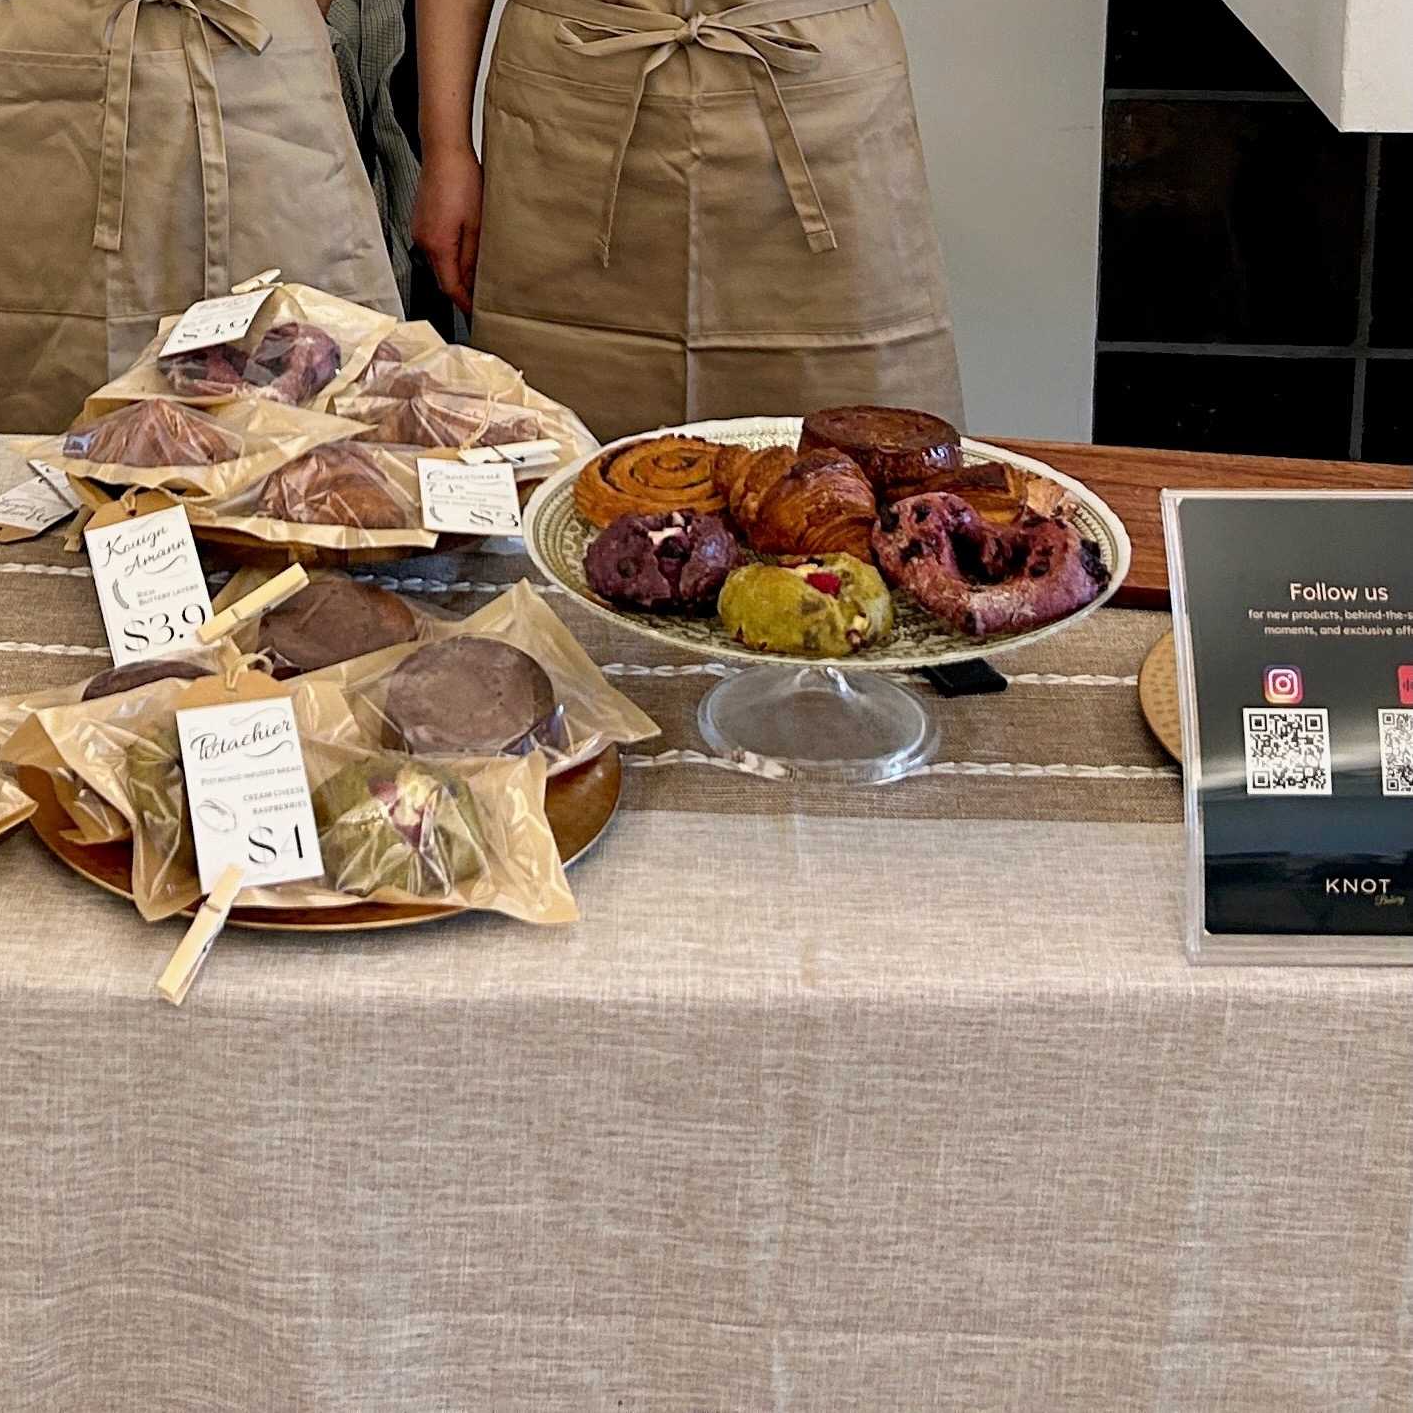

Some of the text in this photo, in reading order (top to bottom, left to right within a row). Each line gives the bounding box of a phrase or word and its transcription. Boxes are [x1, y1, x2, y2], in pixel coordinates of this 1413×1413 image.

[1289, 582, 1389, 601] Follow us
[1248, 609, 1264, 619] for
[1266, 611, 1289, 619] new
[1291, 609, 1344, 622] products,
[124, 603, 206, 653] $3.9
[1264, 625, 1319, 636] moments,
[1319, 625, 1341, 635] and
[1343, 625, 1393, 635] exclusive
[1325, 877, 1392, 894] KNOT
